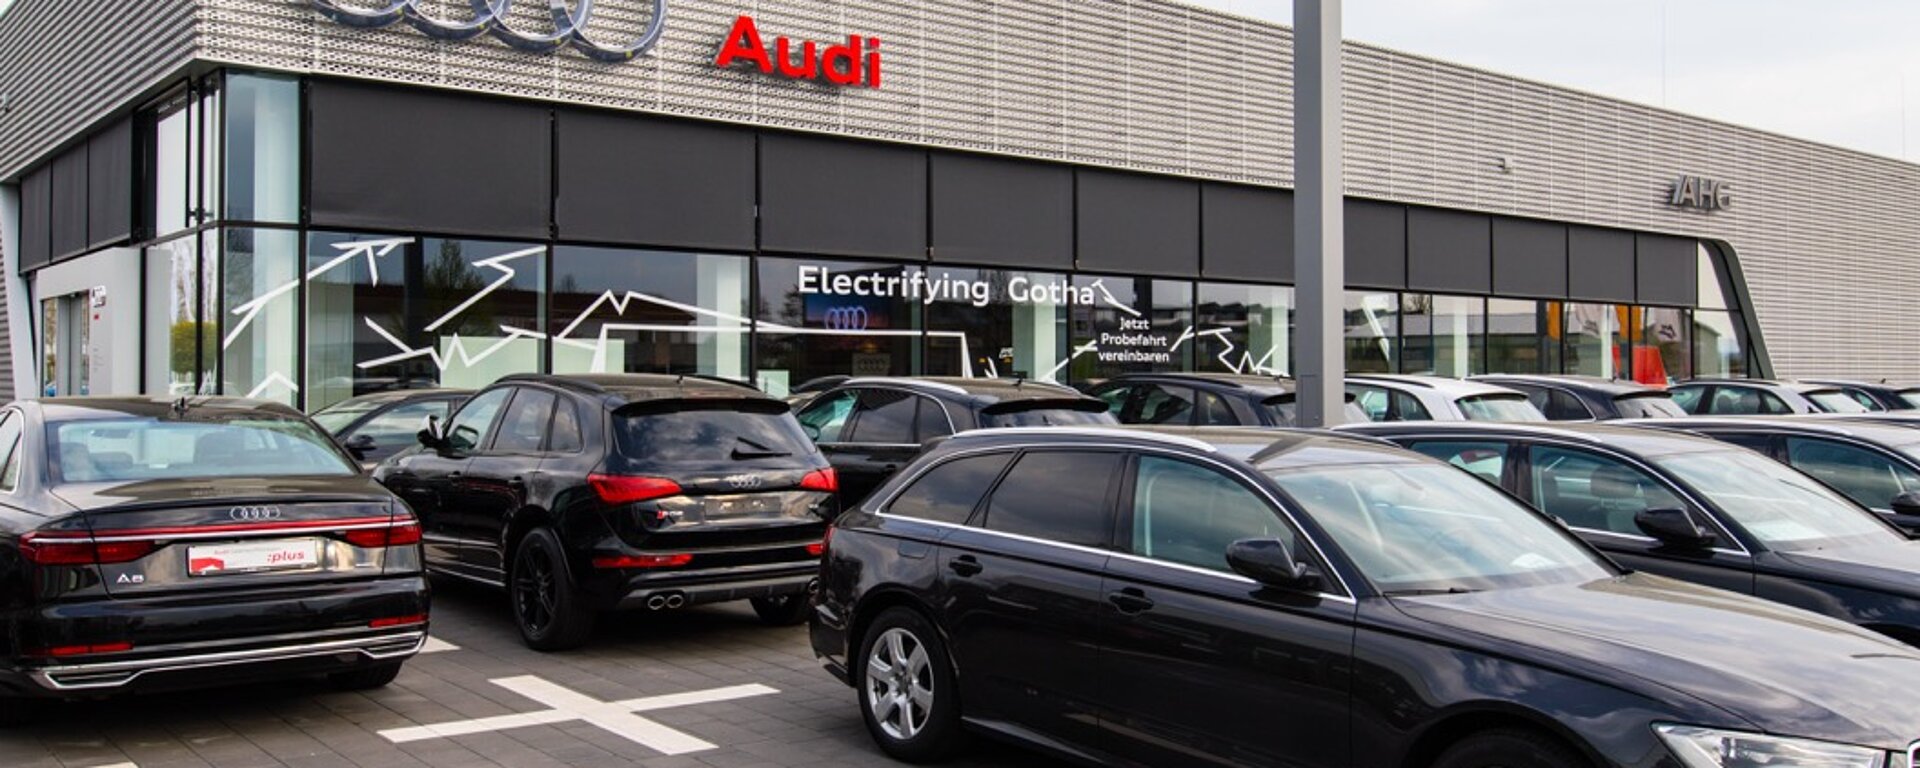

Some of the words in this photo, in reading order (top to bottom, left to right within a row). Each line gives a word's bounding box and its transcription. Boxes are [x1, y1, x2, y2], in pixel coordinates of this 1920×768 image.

[716, 15, 881, 89] Audi
[799, 265, 989, 306] Electrifying
[1008, 276, 1095, 305] Gotha
[1120, 317, 1149, 331] Jetzt
[1101, 332, 1167, 346] Probefahrt
[1098, 349, 1169, 362] vereinbaren
